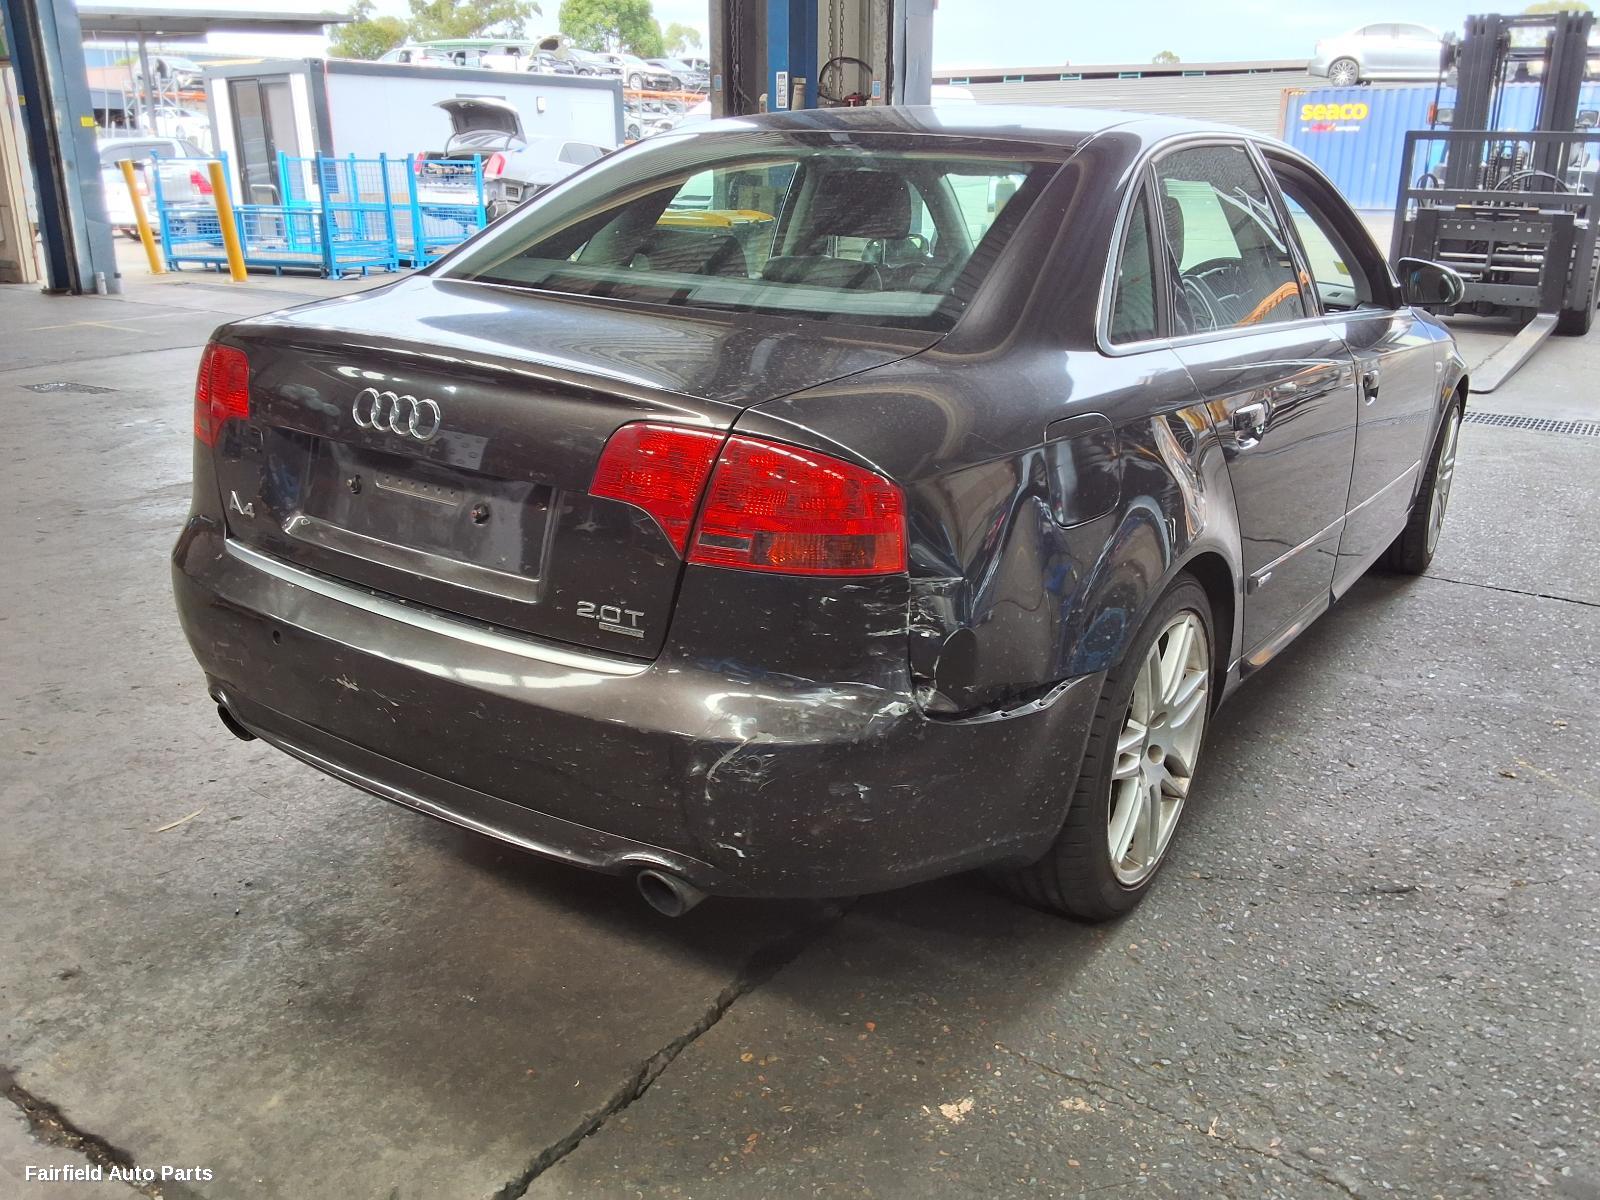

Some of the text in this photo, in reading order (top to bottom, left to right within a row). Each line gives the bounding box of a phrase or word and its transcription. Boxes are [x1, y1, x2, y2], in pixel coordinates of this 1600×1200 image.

[1300, 103, 1368, 121] seaco
[230, 490, 255, 518] A4
[576, 600, 645, 627] 2.0T
